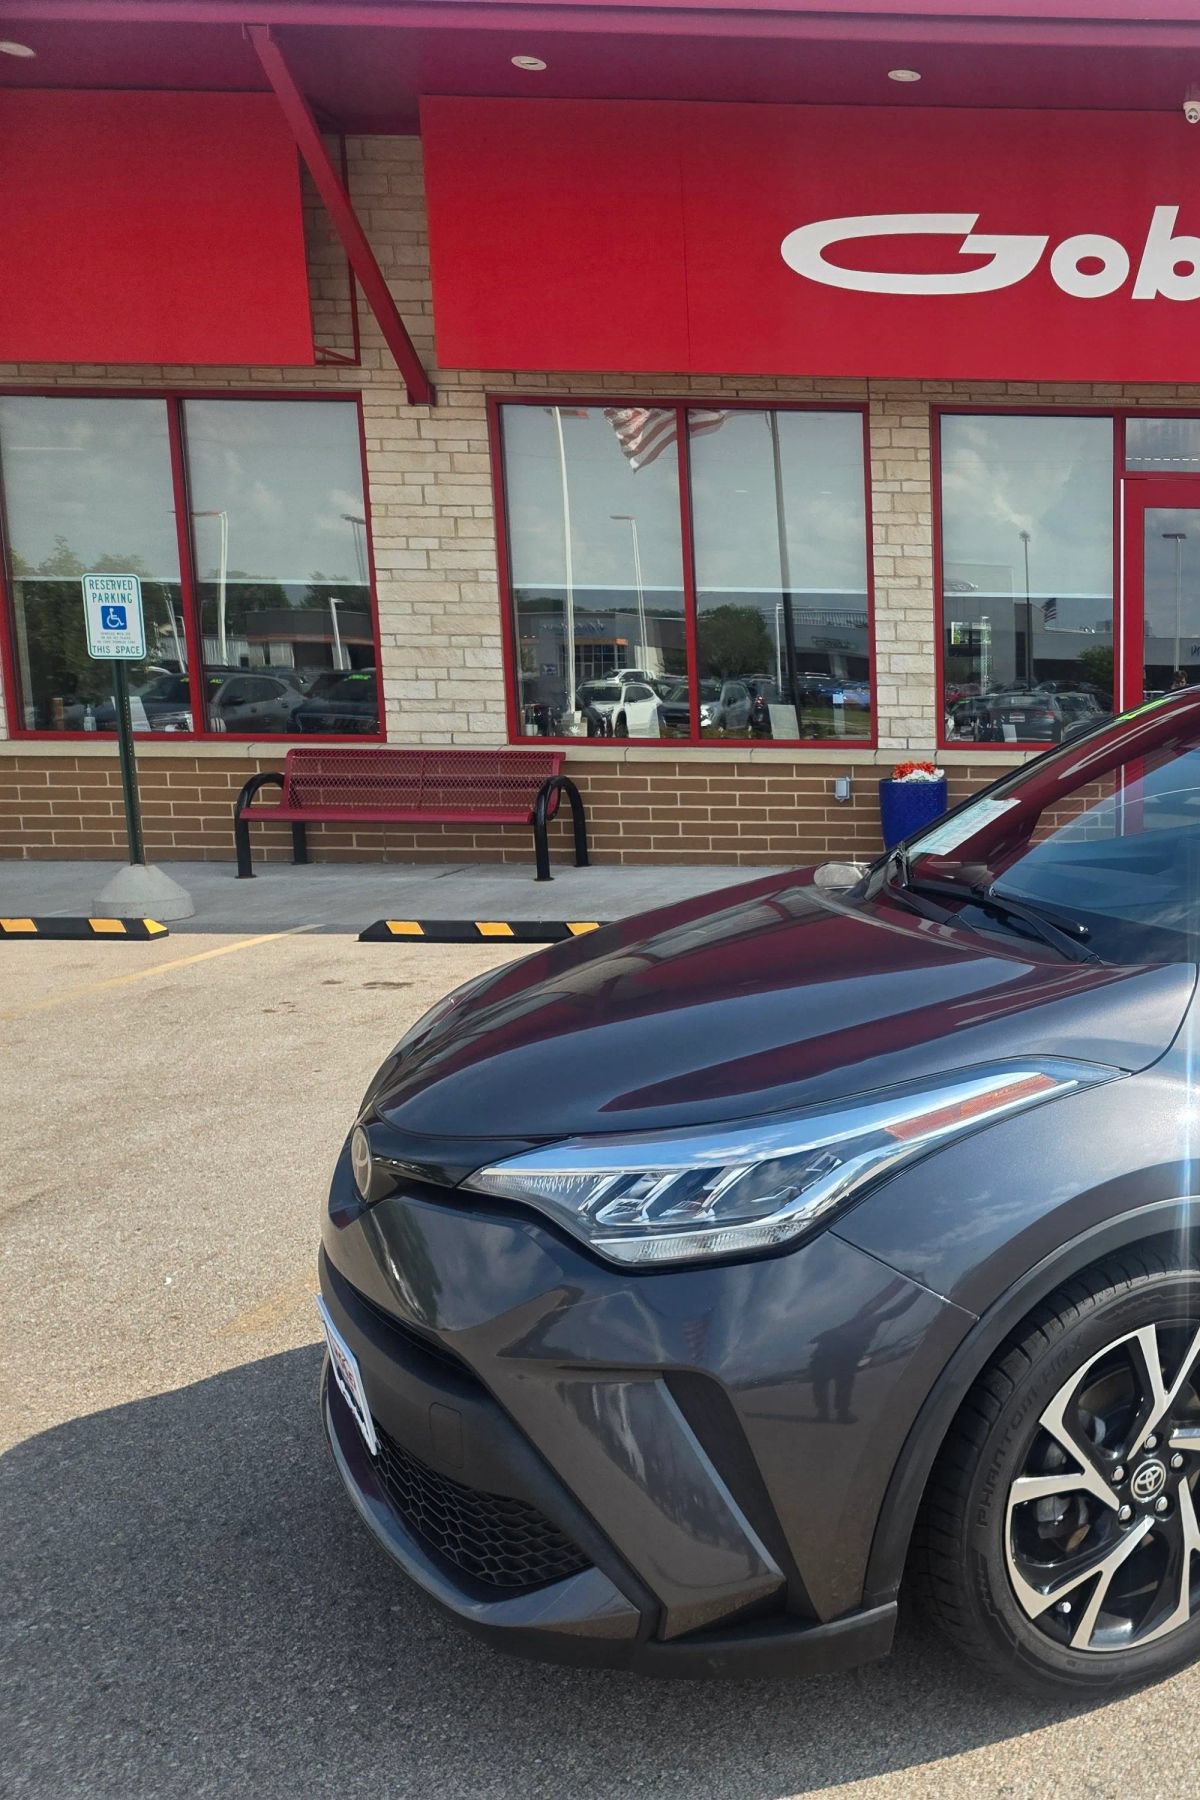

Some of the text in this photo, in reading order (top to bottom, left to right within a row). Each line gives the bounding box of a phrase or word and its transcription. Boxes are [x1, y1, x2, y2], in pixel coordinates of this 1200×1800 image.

[89, 579, 133, 591] RESERVED
[92, 592, 133, 604] PARKING
[92, 645, 141, 655] THIS SPACE
